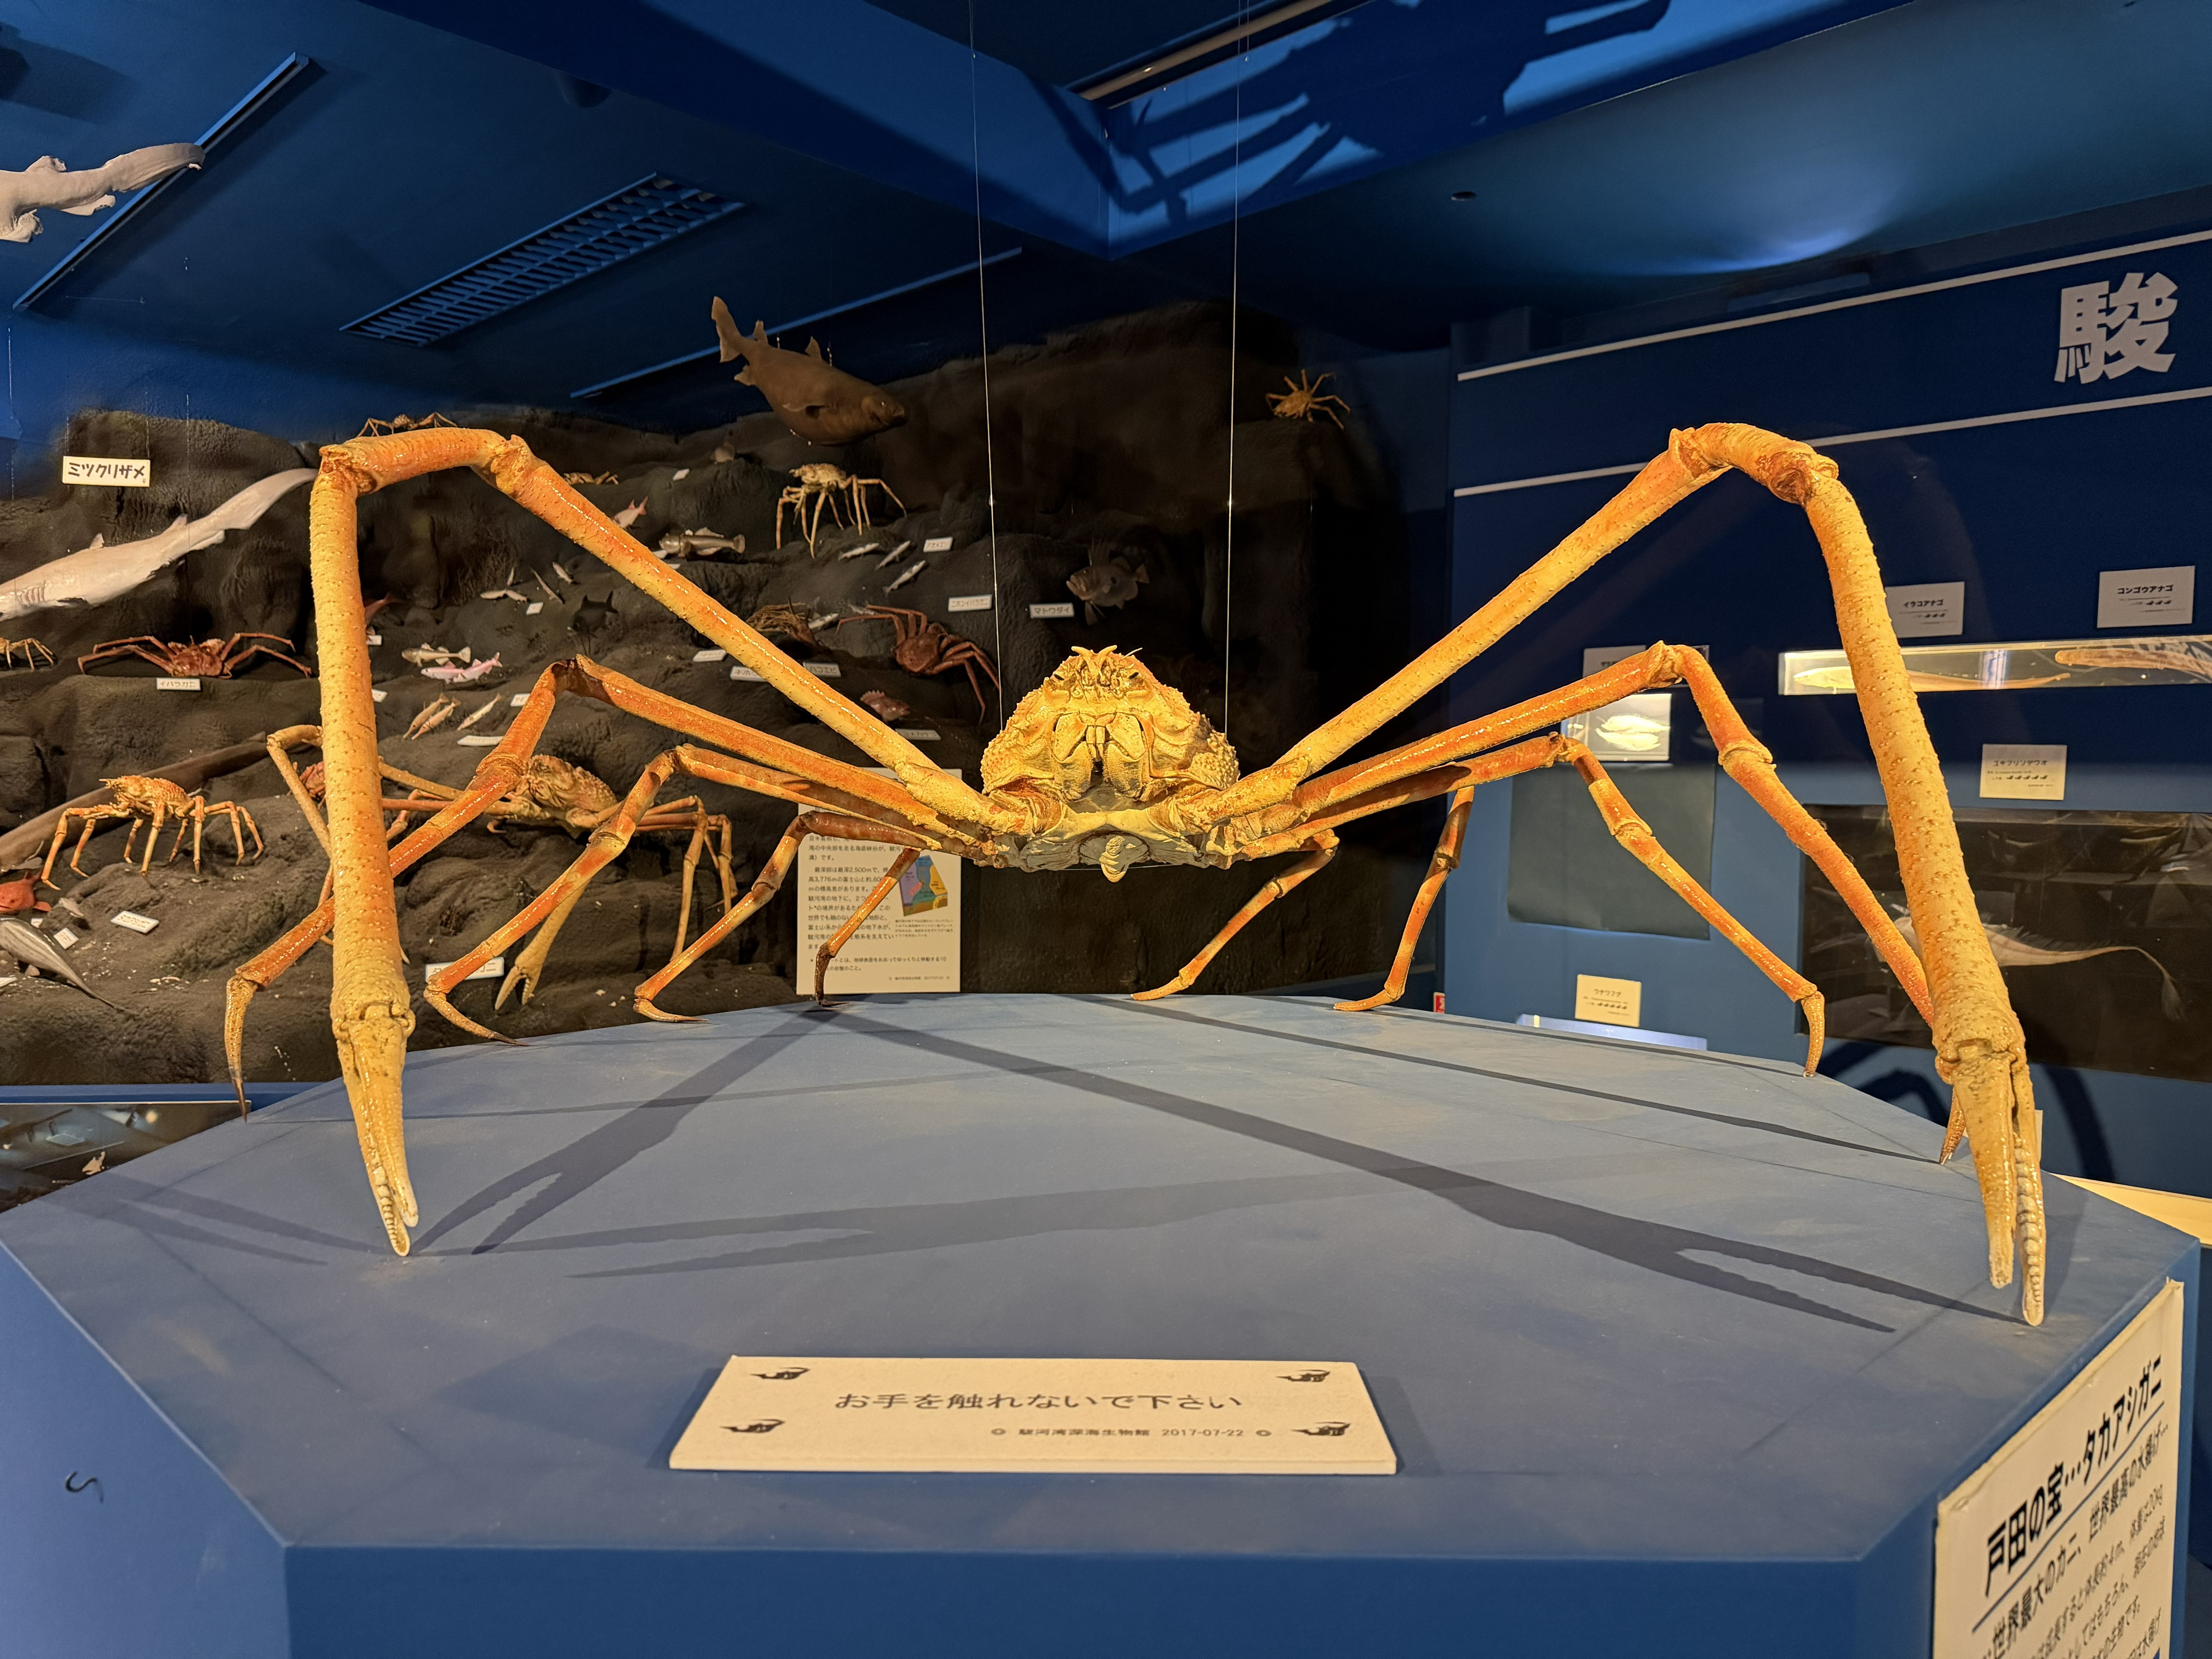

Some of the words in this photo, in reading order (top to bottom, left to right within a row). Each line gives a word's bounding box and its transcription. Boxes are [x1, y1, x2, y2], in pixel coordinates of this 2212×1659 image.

[2054, 272, 2178, 385] 駿
[68, 462, 145, 479] ミツクリザメ
[2117, 585, 2174, 594] コンゴウアナゴ
[835, 1394, 1243, 1410] お手を触れないで下さい
[1018, 1428, 1151, 1437] 駿河湾深海生物館
